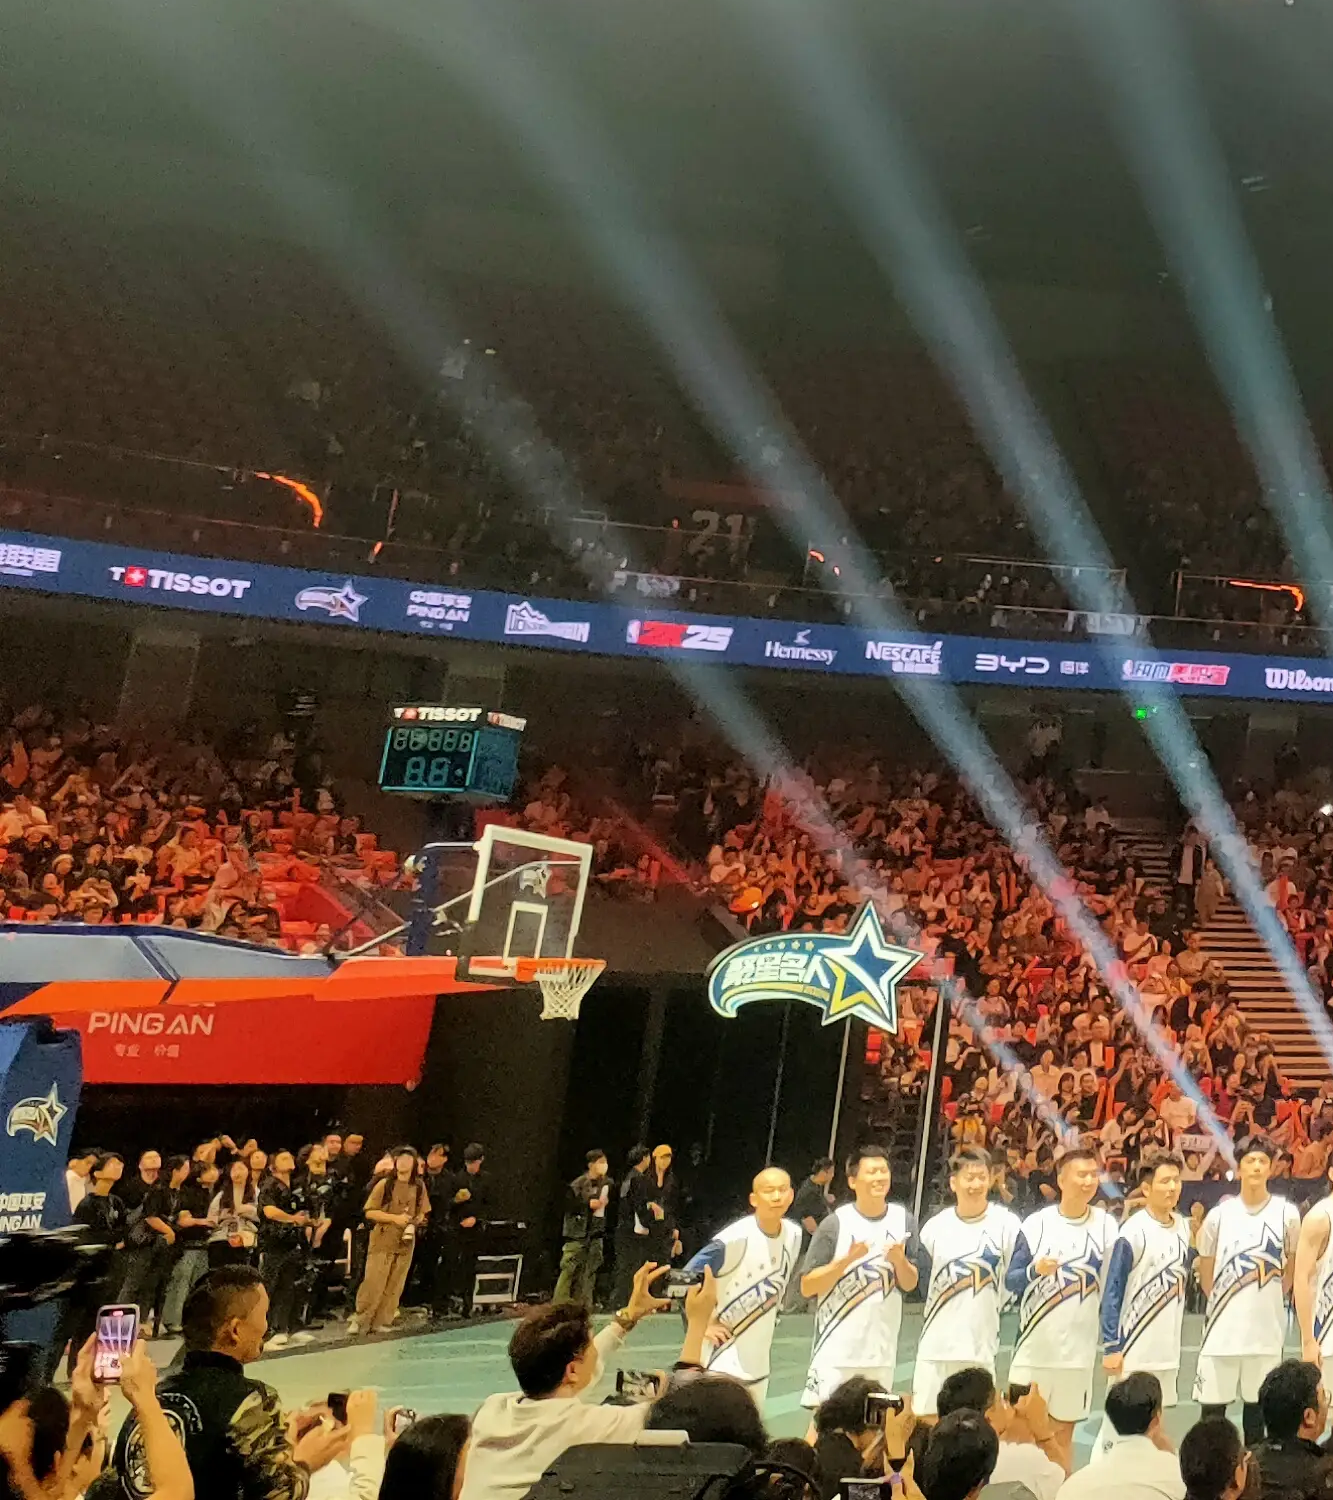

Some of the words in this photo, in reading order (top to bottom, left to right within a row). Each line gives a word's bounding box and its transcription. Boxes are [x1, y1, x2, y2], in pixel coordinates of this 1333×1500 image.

[149, 570, 251, 598] TISSOT
[765, 640, 838, 666] Hennessy
[975, 653, 1050, 674] BYD
[417, 707, 482, 722] TISSOT
